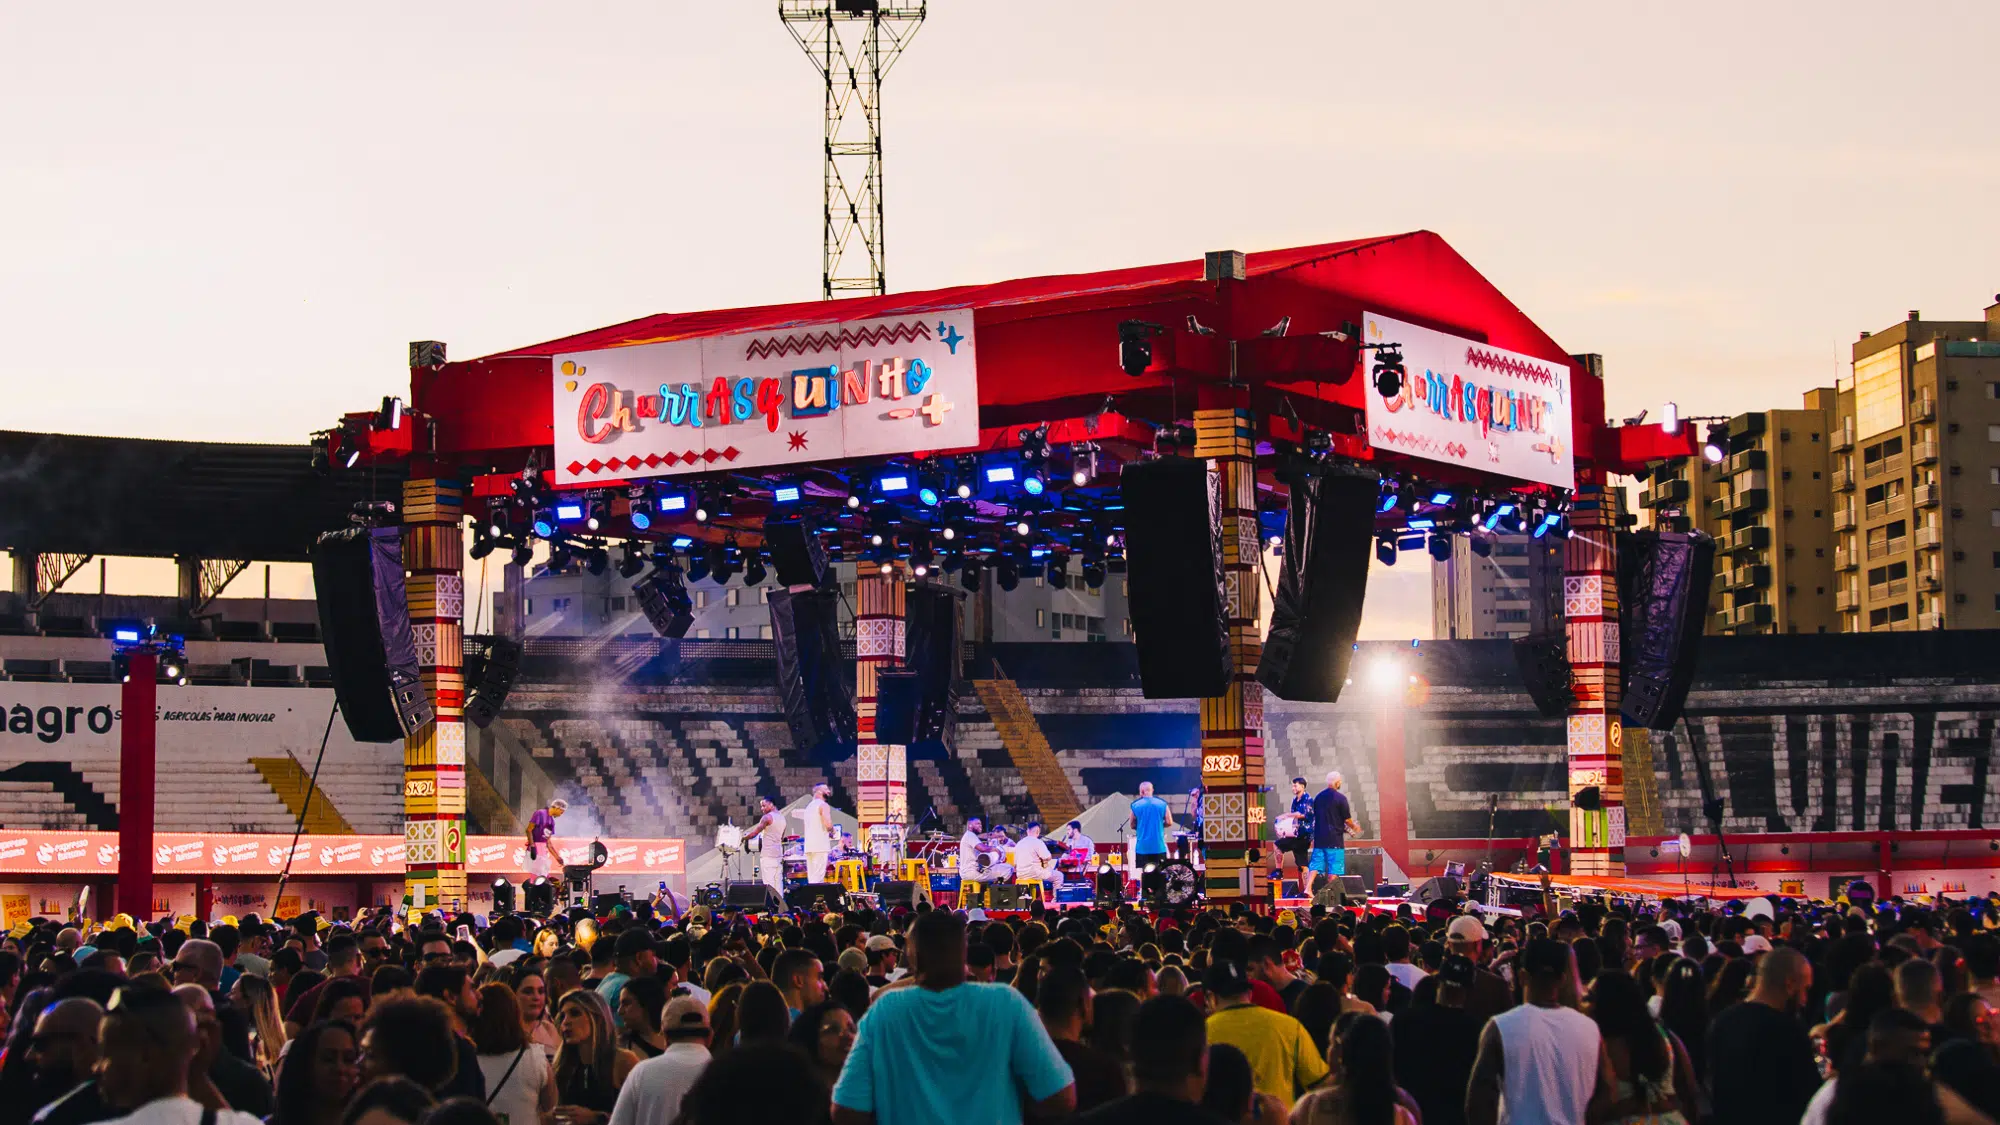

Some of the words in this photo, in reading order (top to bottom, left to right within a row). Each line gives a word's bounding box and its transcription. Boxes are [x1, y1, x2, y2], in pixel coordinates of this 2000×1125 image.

[0, 703, 113, 743] agro
[213, 712, 236, 722] PARA
[237, 713, 275, 722] INOVAR
[1203, 755, 1242, 772] SKOL
[405, 780, 435, 796] SKOL
